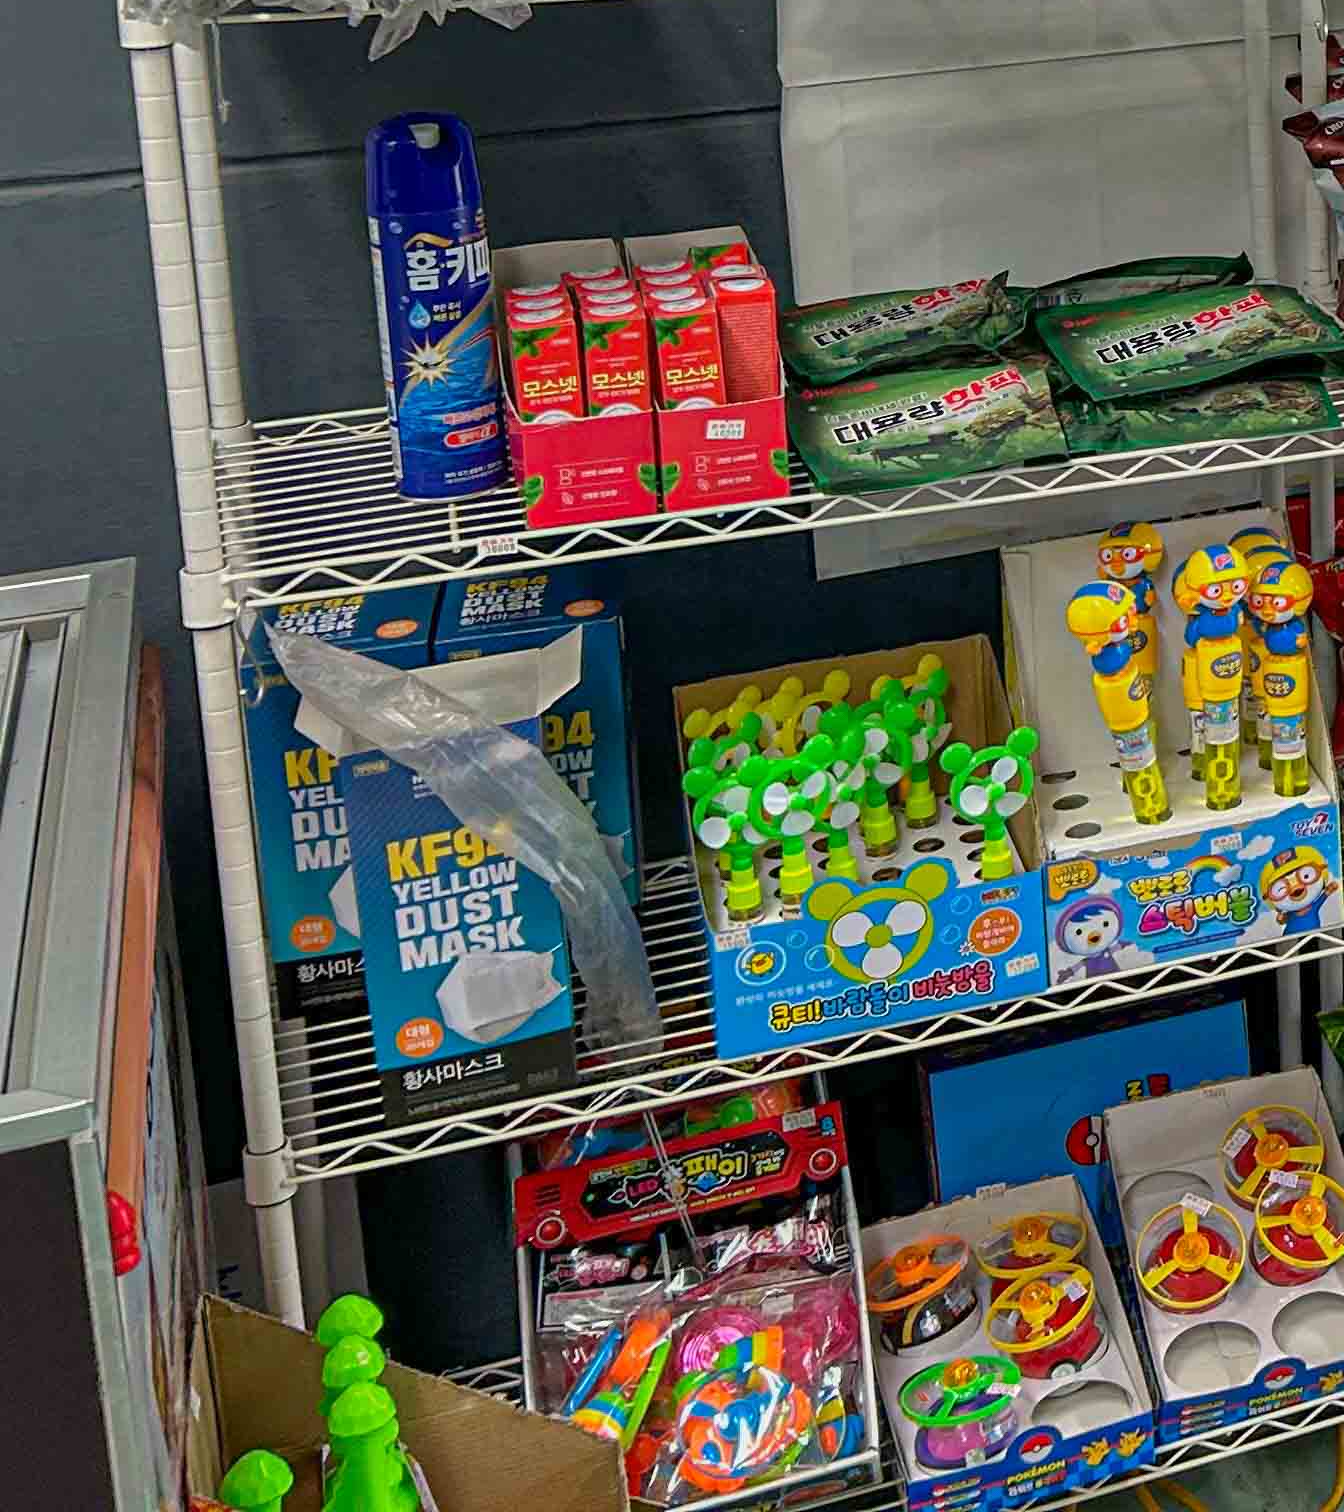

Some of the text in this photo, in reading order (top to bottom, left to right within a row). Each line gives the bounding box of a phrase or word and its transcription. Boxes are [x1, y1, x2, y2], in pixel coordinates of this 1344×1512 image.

[523, 374, 578, 395] 모스넷
[592, 371, 646, 389] 모스넷
[666, 364, 719, 383] 모스넷
[462, 598, 543, 616] MASK
[464, 591, 544, 609] DUST
[386, 823, 507, 884] KF9
[391, 861, 518, 904] YELLOW
[1128, 868, 1193, 901] 뽀로로
[394, 884, 520, 939] DUST
[1137, 884, 1257, 935] 스틱버블
[400, 917, 526, 974] MASK
[770, 961, 994, 1031] 큐티! 바람돌이 비눗방울
[402, 1052, 506, 1090] 황사마스크
[628, 1179, 661, 1197] LED
